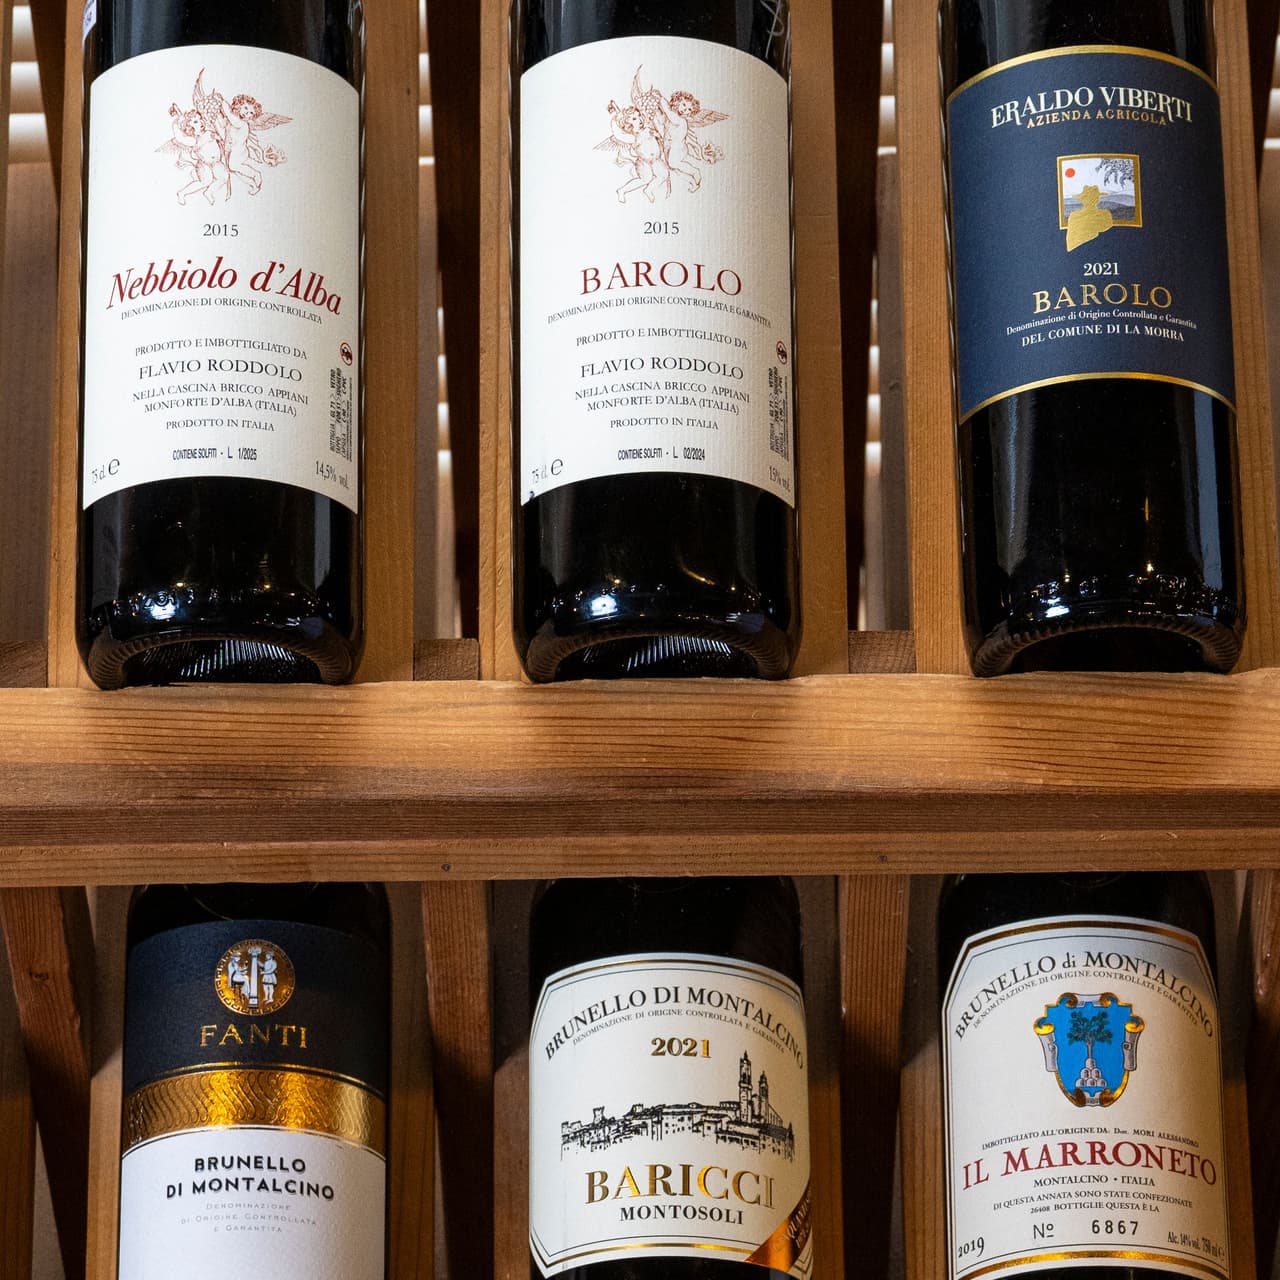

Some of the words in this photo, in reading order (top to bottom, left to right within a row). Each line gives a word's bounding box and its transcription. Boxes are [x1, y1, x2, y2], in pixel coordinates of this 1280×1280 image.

[990, 86, 1094, 129] ERALDO
[1099, 86, 1193, 124] VIBERTI
[1027, 108, 1092, 129] AZIENDA
[1096, 109, 1167, 126] AGRICOLA
[203, 224, 240, 238] 2015
[643, 221, 680, 236] 2015
[580, 261, 743, 297] BAROLO
[1083, 262, 1120, 277] 2021
[106, 255, 238, 310] Nebbiolo
[249, 259, 343, 317] d'Alba
[1032, 283, 1173, 314] BAROLO
[1021, 333, 1045, 347] DEL
[1048, 324, 1103, 339] COMUNE
[1106, 324, 1121, 334] DI
[1125, 325, 1141, 335] LA
[1144, 325, 1184, 342] MORRA
[138, 359, 202, 381] FLAVIO
[207, 359, 303, 383] RODDOLO
[580, 357, 644, 378] FLAVIO
[650, 357, 745, 381] RODDOLO
[955, 955, 1056, 1039] BRUNELLO
[1062, 951, 1076, 969] di
[1083, 951, 1214, 1038] MONTALCINO
[200, 1023, 308, 1049] FANTI
[545, 989, 647, 1061] BRUNELLO
[653, 986, 680, 1005] DI
[687, 986, 804, 1069] MONTALCINO
[650, 1037, 712, 1058] 2021
[194, 1155, 306, 1174] BRUNELLO
[962, 1159, 990, 1192] IL
[1000, 1140, 1217, 1186] MARRONETO
[166, 1184, 183, 1199] DI
[192, 1177, 335, 1200] MONTALCINO
[585, 1163, 775, 1210] BARICCI
[620, 1204, 744, 1225] MONTOSOLI
[1091, 1219, 1139, 1236] 6867
[958, 1237, 985, 1259] 2019
